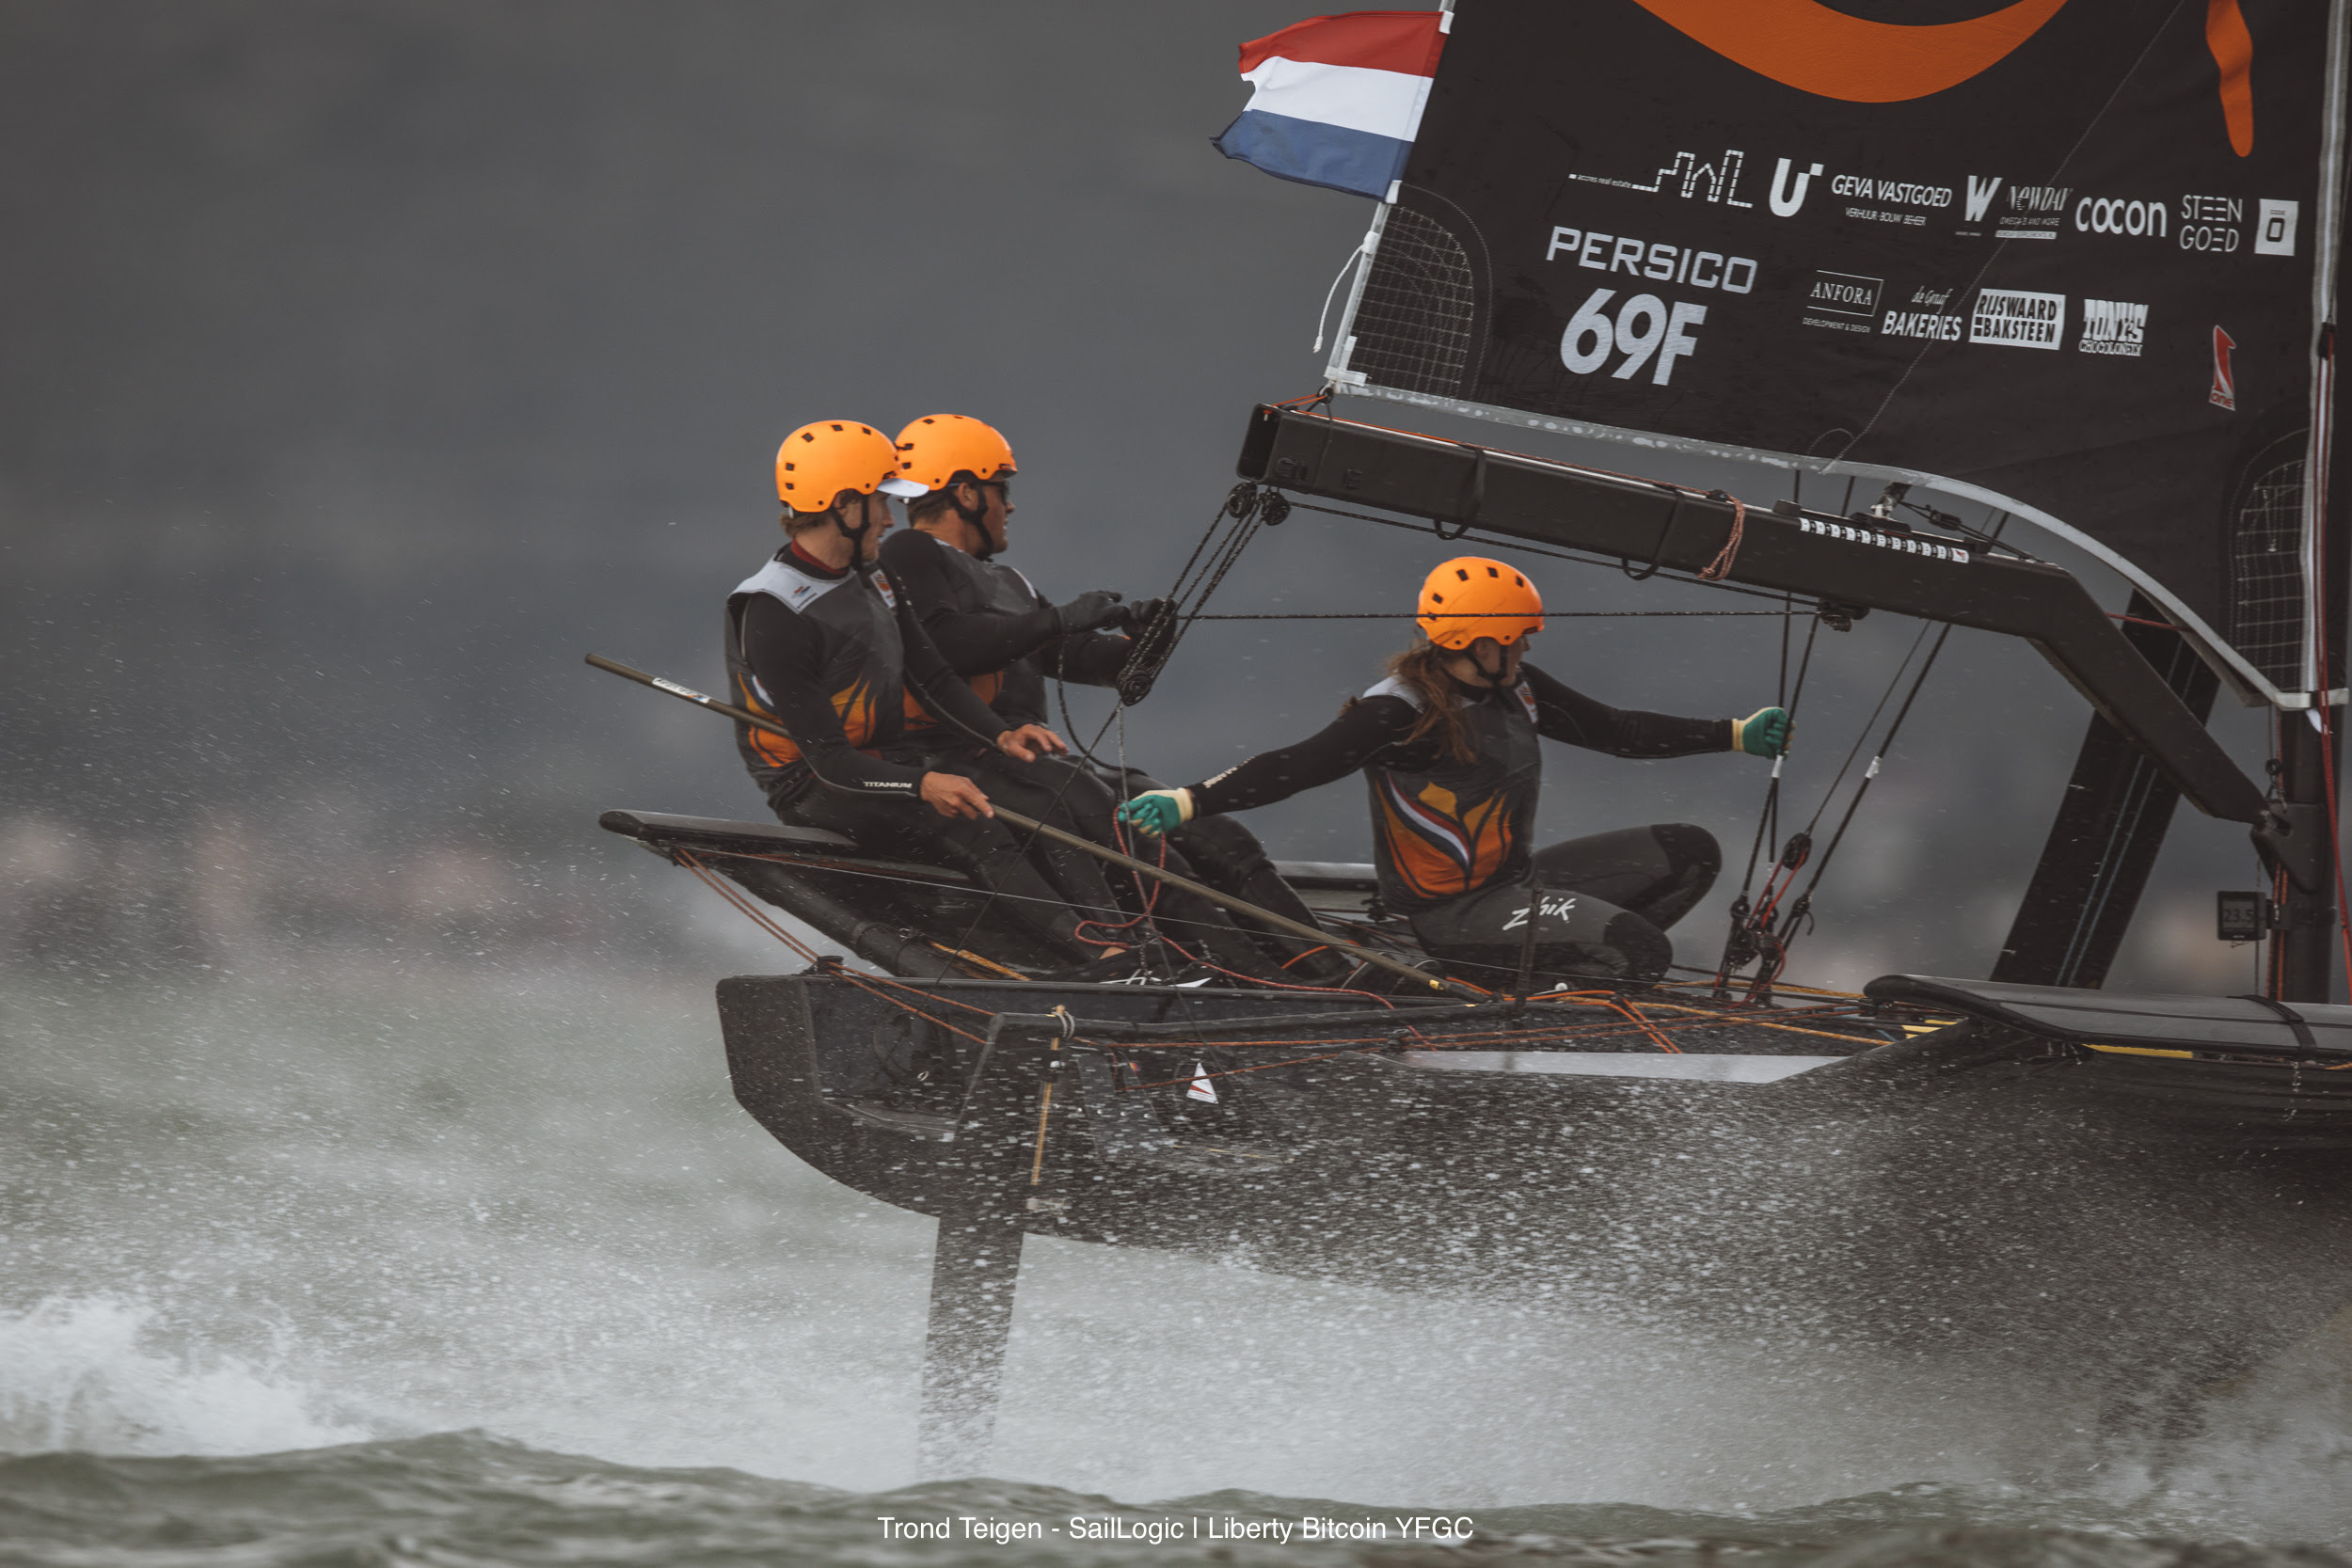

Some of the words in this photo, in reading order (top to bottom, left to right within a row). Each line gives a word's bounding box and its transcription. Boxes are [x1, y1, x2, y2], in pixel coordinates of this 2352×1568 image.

[1831, 174, 1873, 199] GEVA
[1878, 180, 1953, 208] VASTGOED
[2181, 194, 2243, 223] STEEN
[2179, 225, 2240, 252] GOED
[1546, 226, 1757, 294] PERSICO
[1809, 281, 1872, 306] ANFORA
[1976, 294, 2058, 321] RIJSWAARD
[1560, 288, 1708, 387] 69F
[1881, 310, 1963, 341] BAKERIES
[1982, 316, 2056, 343] BAKSTEEN
